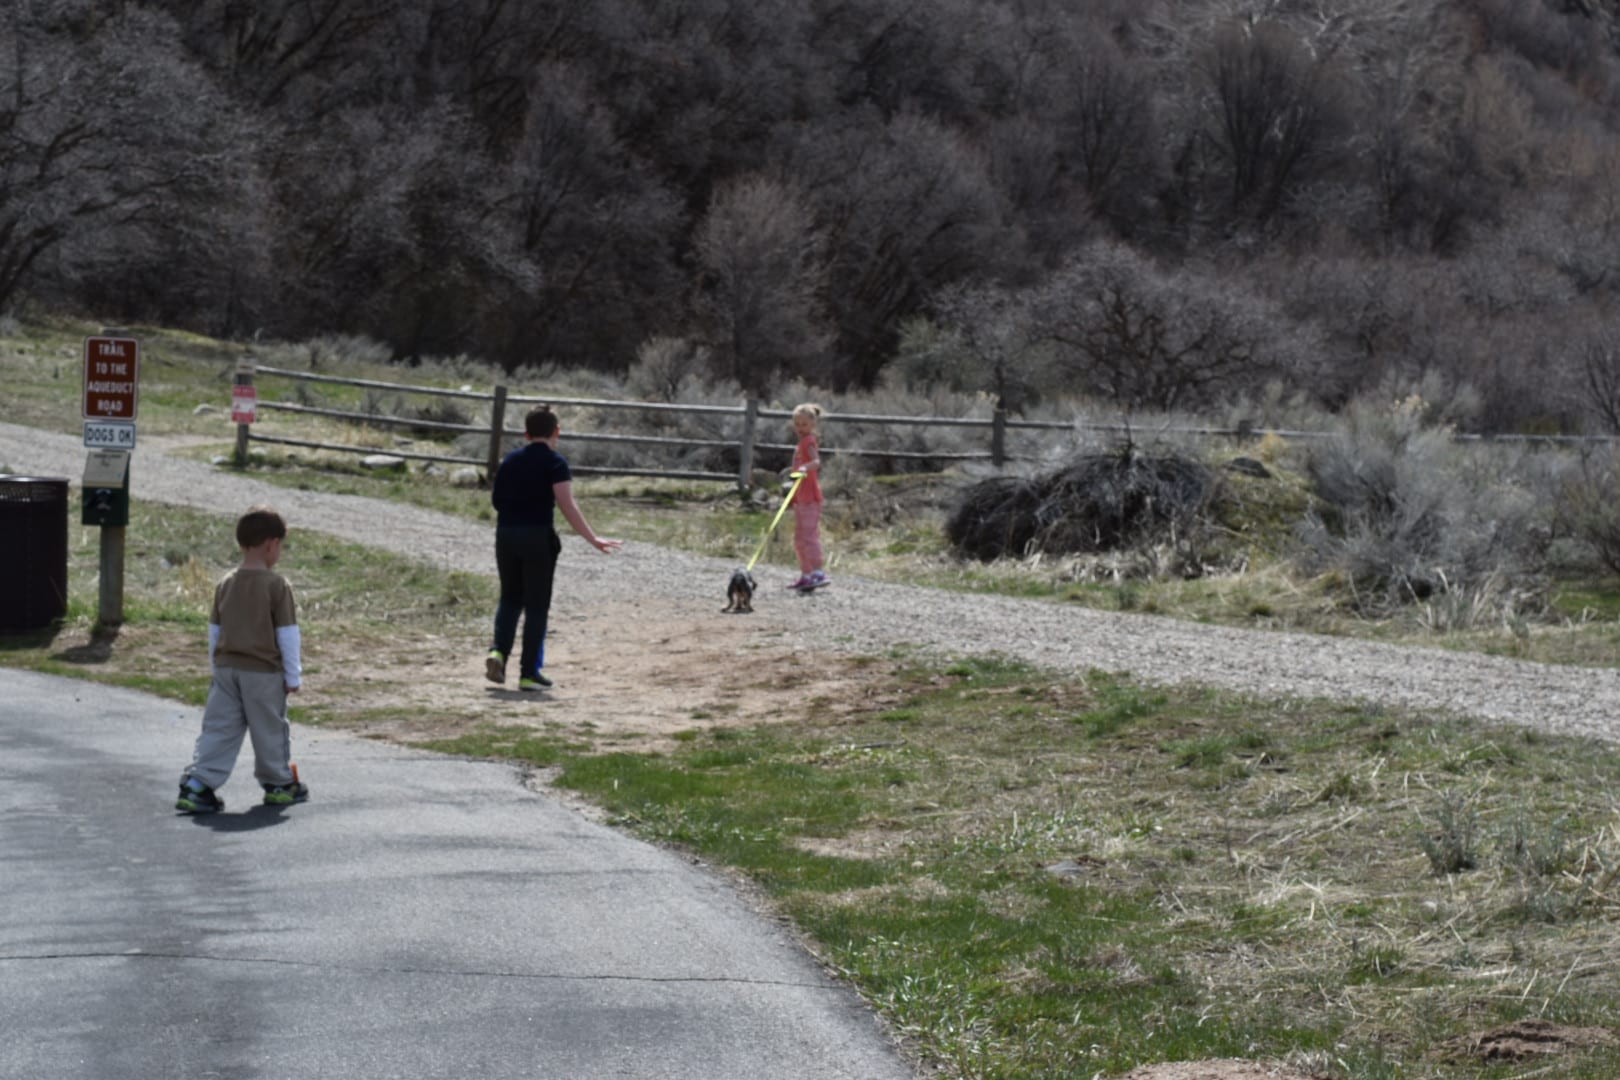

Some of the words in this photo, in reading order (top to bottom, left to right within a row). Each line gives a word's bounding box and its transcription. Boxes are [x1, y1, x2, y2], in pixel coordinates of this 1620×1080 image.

[98, 343, 126, 356] TRAIL
[96, 362, 108, 375] TO
[110, 362, 127, 375] THE
[88, 381, 133, 394] AQUEDUCT
[97, 399, 123, 411] ROAD
[87, 427, 114, 442] DOGS
[118, 429, 132, 443] OK
